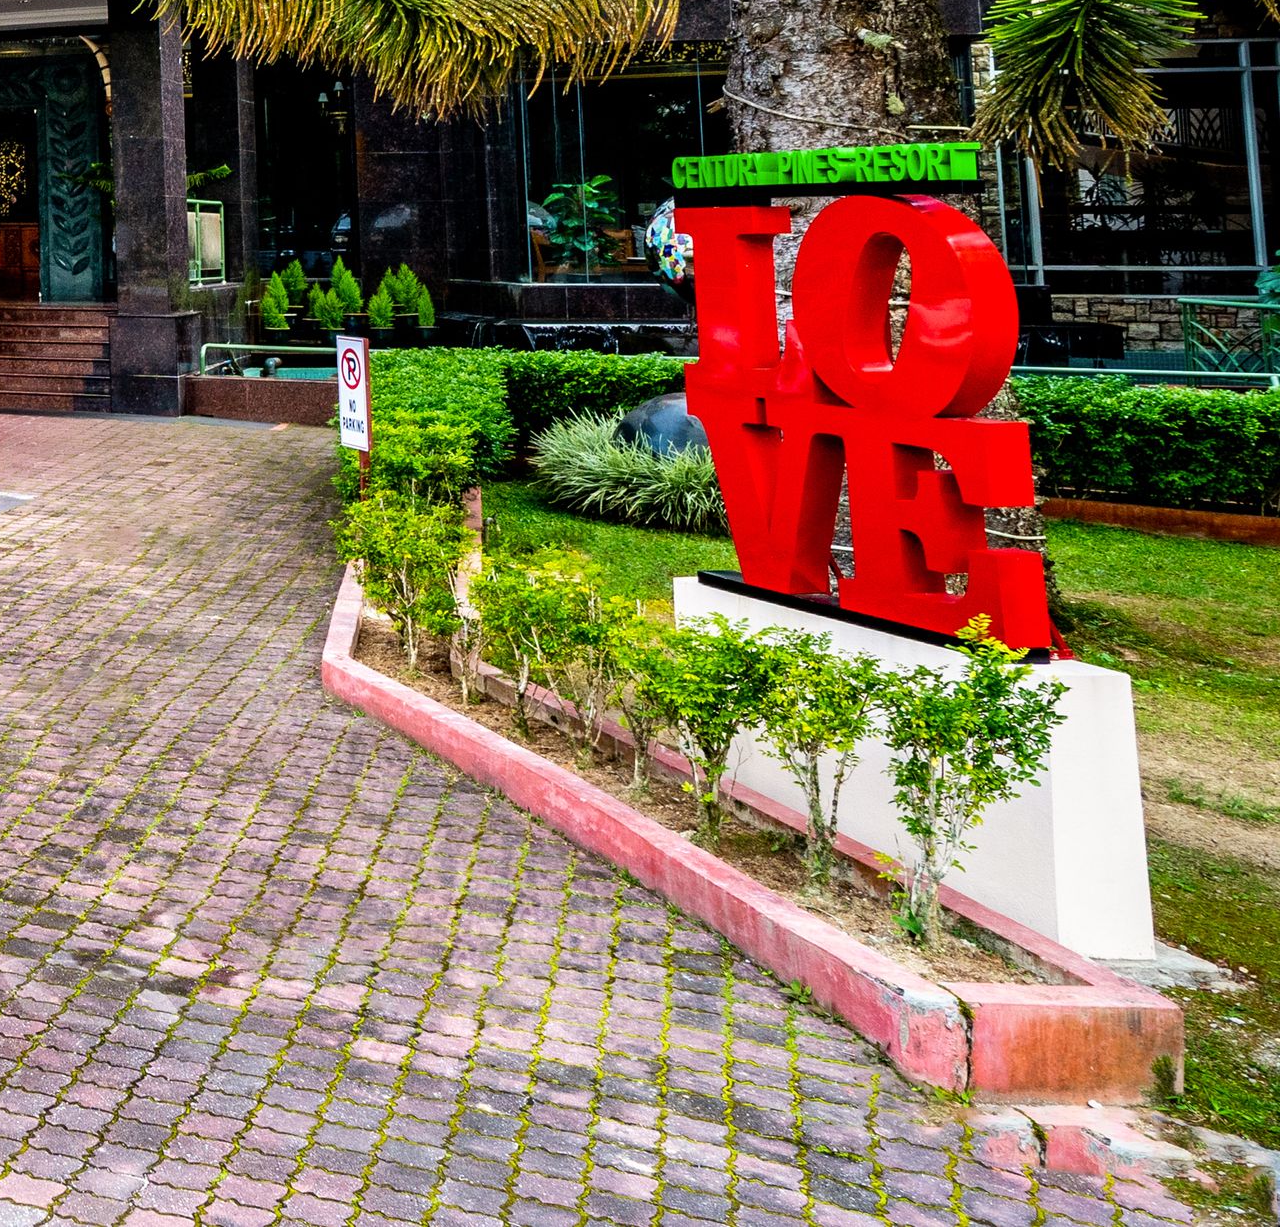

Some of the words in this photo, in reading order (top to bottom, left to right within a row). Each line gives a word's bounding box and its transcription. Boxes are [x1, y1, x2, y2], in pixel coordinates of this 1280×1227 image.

[671, 153, 765, 189] CENTURY
[777, 148, 841, 184] PINES
[854, 143, 981, 182] RESORT
[348, 398, 357, 414] NO
[342, 416, 365, 434] PARKING
